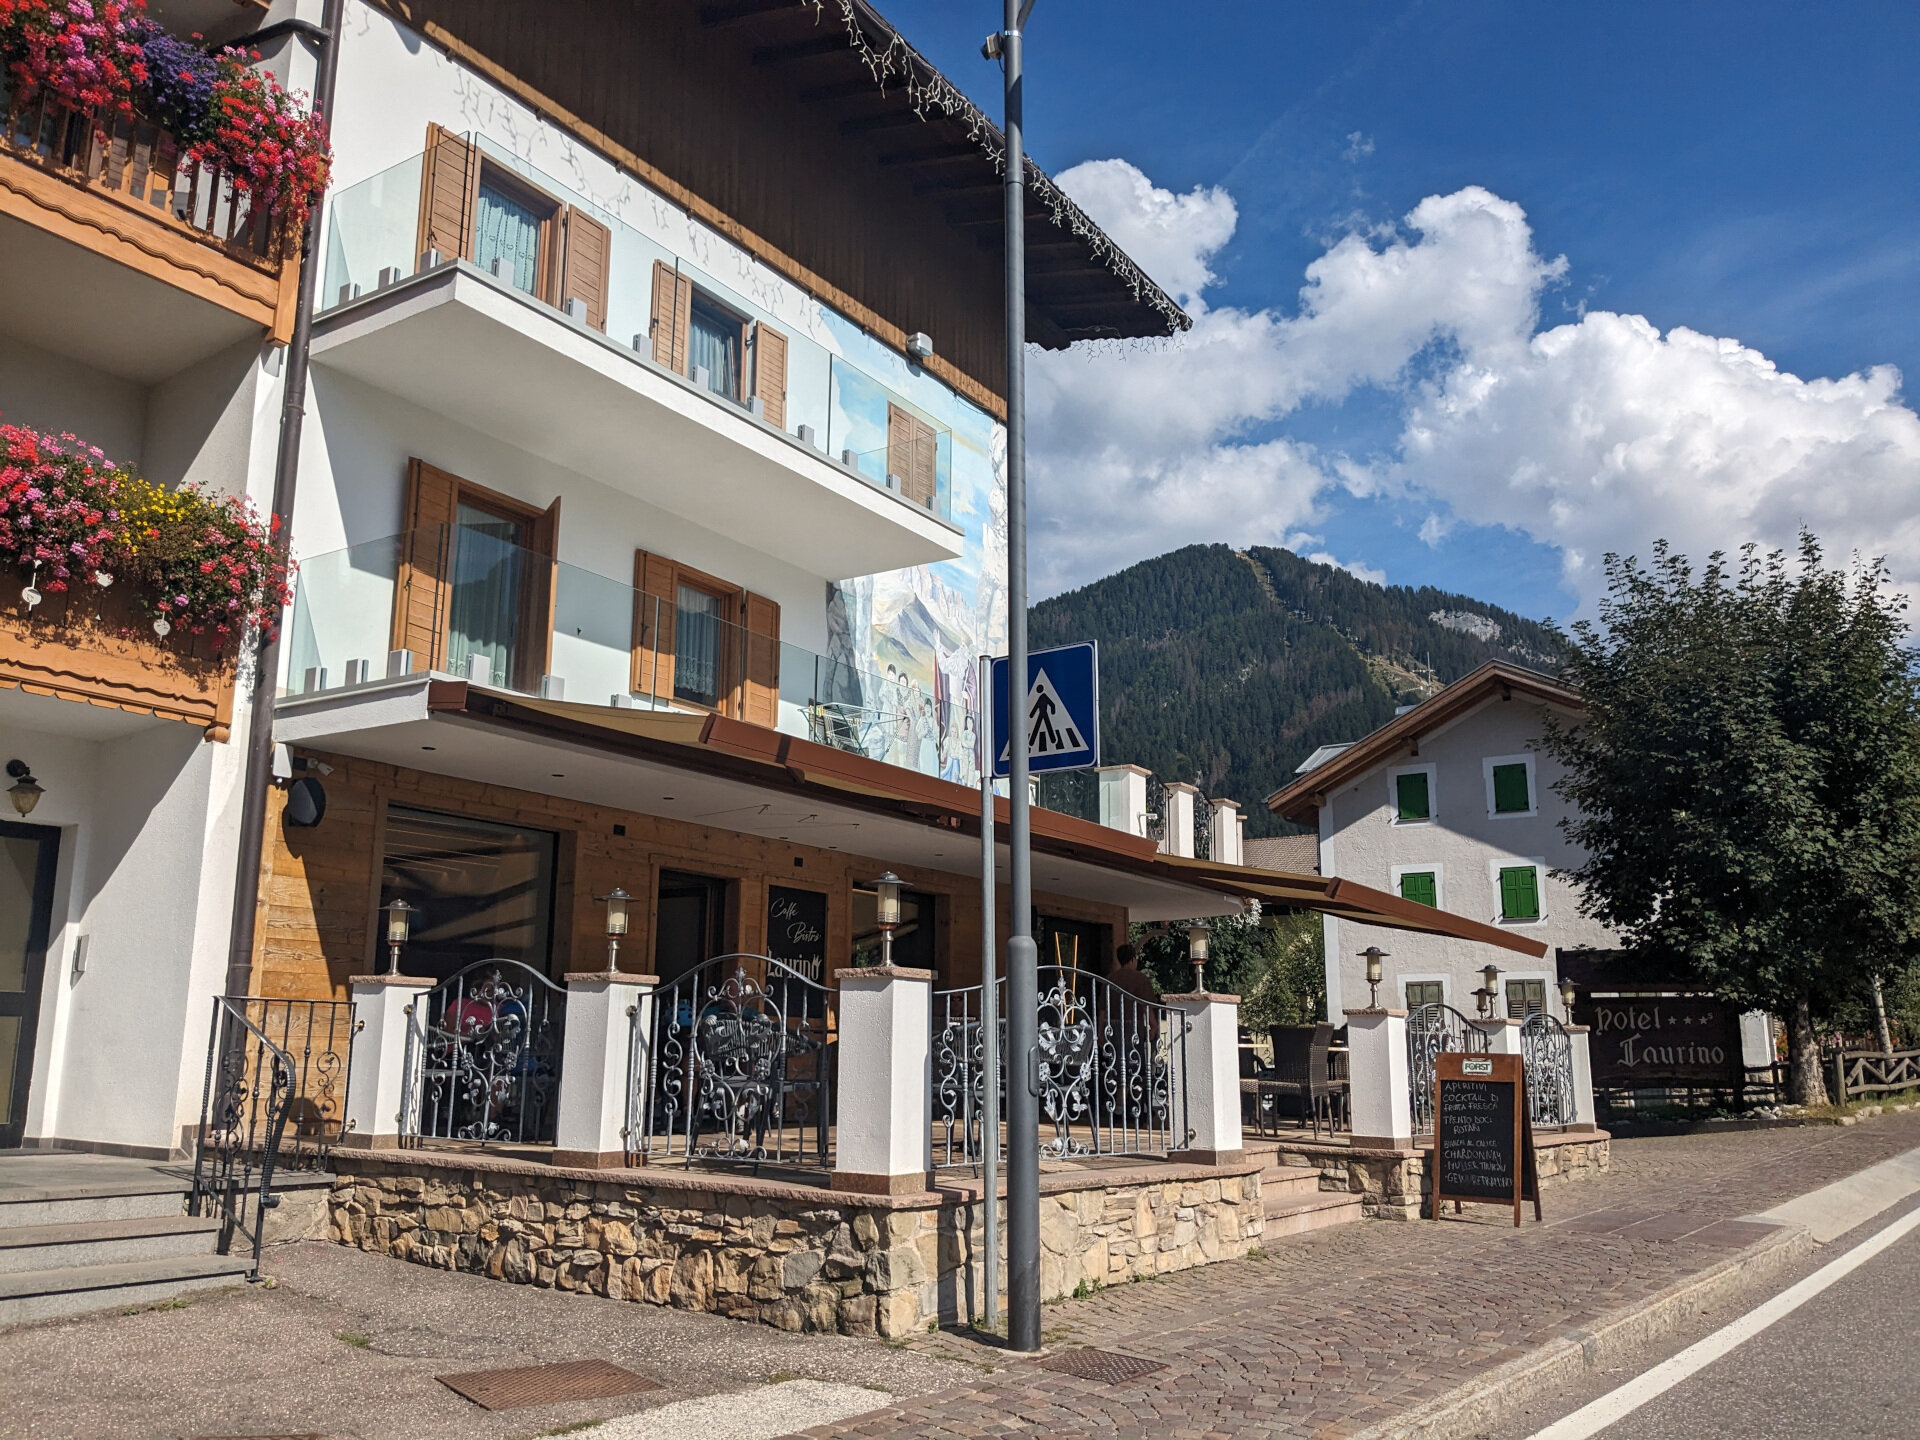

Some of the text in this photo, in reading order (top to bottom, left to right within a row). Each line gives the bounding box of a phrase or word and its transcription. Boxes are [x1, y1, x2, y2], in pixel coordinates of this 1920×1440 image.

[1617, 1032, 1725, 1068] Laurino
[1464, 1063, 1490, 1071] FORST
[1444, 1082, 1487, 1092] APERITIVI
[1443, 1093, 1499, 1102] COCKTAIL DI
[1468, 1102, 1498, 1111] FRESCA
[1443, 1114, 1473, 1124] TRENTO
[1444, 1148, 1502, 1163] CHARDONNAY
